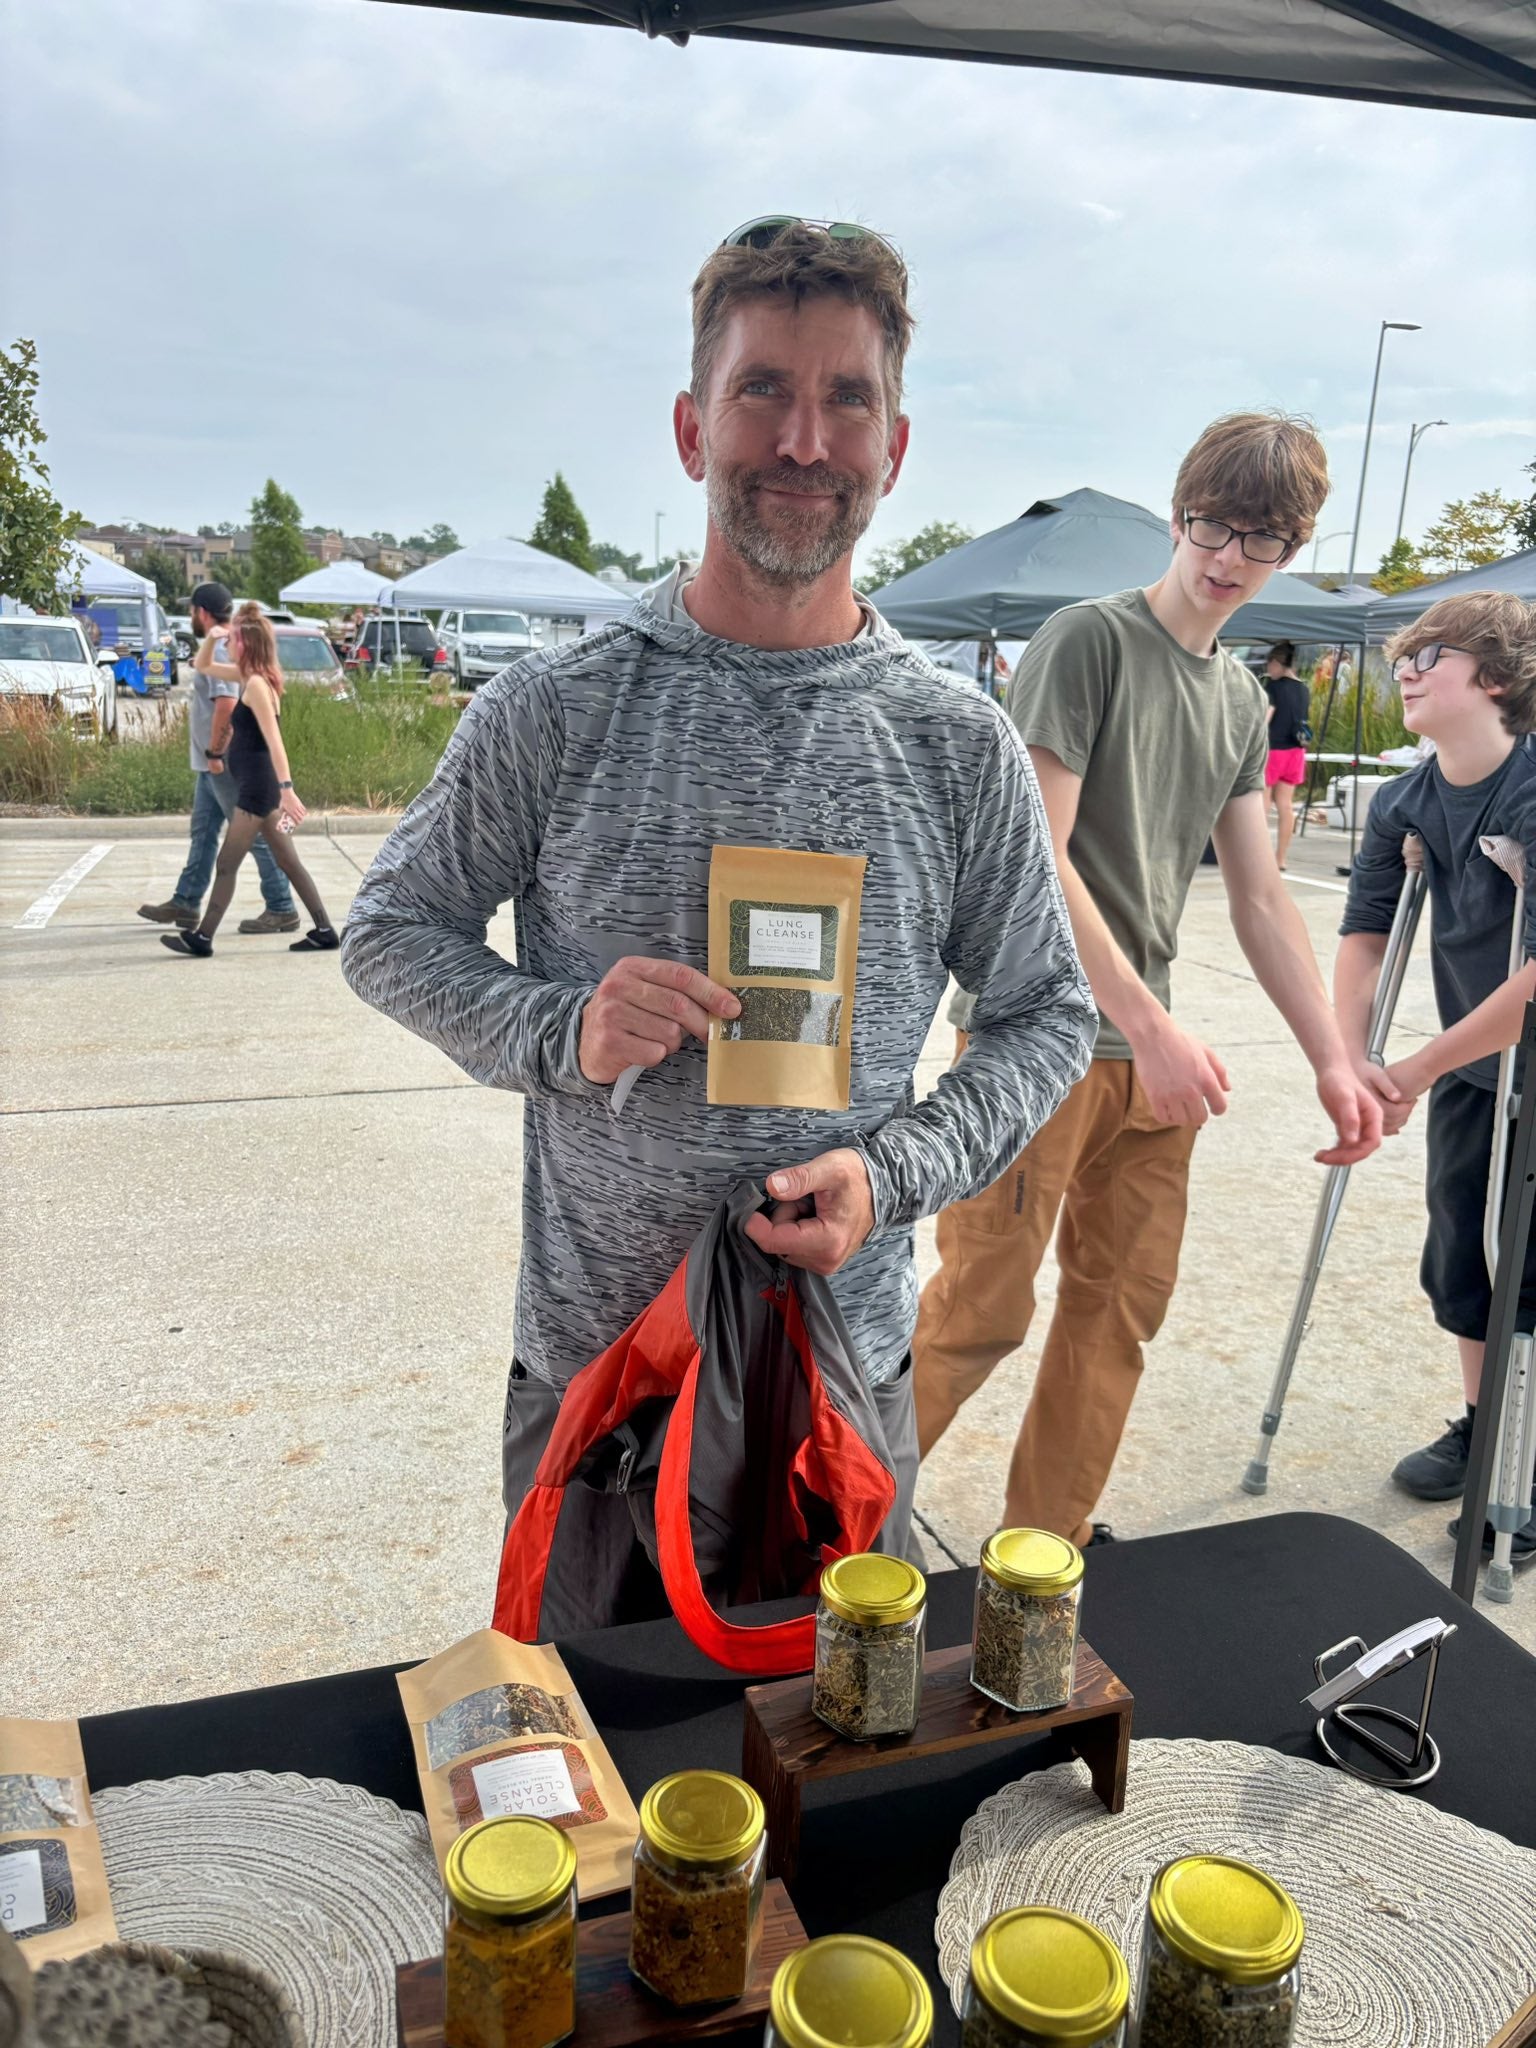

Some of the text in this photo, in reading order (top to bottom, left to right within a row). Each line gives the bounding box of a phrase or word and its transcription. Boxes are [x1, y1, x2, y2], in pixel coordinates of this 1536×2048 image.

[768, 920, 803, 929] LUNG
[756, 928, 815, 940] CLEANSE
[489, 1780, 565, 1805] CLEANSE
[504, 1792, 558, 1813] SOLAR
